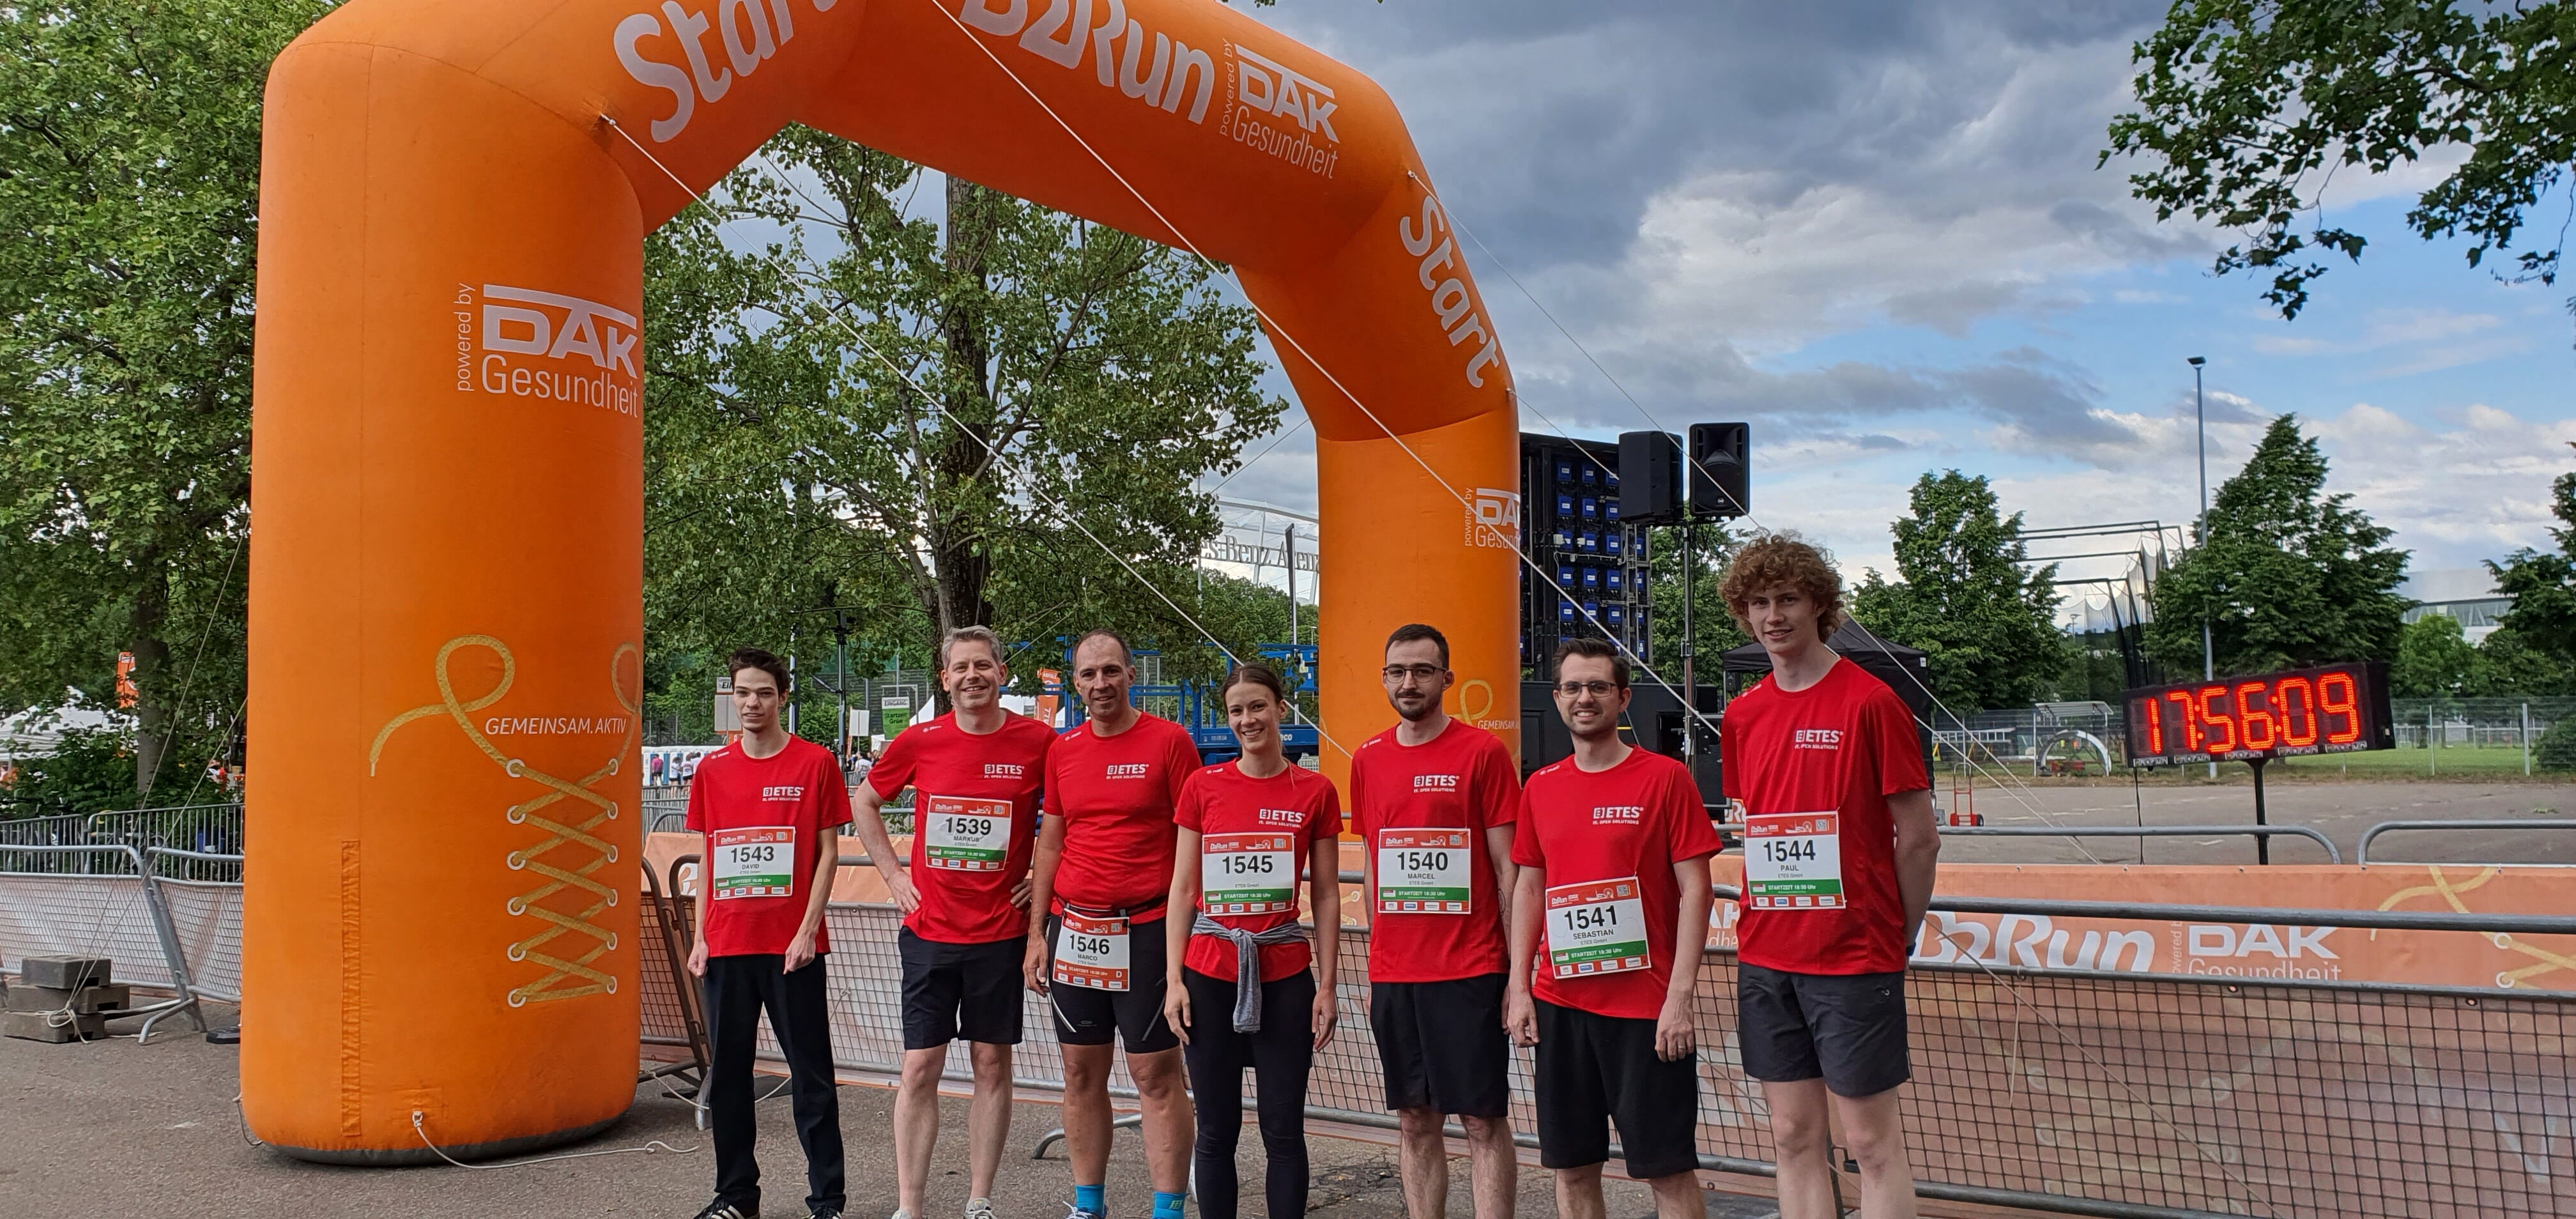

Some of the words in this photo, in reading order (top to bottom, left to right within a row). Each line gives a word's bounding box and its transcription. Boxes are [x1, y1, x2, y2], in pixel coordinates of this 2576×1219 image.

[1222, 38, 1232, 58] by
[613, 0, 836, 142] Star
[1220, 62, 1234, 136] powered
[1234, 43, 1340, 144] DAK
[1233, 105, 1338, 179] Gesundheit
[454, 282, 475, 305] by
[1400, 195, 1499, 388] Start
[482, 284, 638, 379] DAK
[454, 312, 475, 392] powered
[482, 354, 638, 418] Gesundheit
[1463, 487, 1473, 500] by
[1475, 488, 1521, 530] DA
[2147, 671, 2360, 755] 17:56:09
[946, 816, 992, 836] 1539
[731, 846, 774, 863] 1543
[1222, 855, 1273, 874] 1545
[1397, 852, 1448, 871] 1540
[1763, 839, 1816, 862] 1544
[1564, 905, 1617, 931] 1541
[1573, 928, 1614, 940] SEBASTIAN
[1070, 934, 1110, 954] 1546
[2171, 930, 2182, 974] owered
[2189, 924, 2340, 959] DAK
